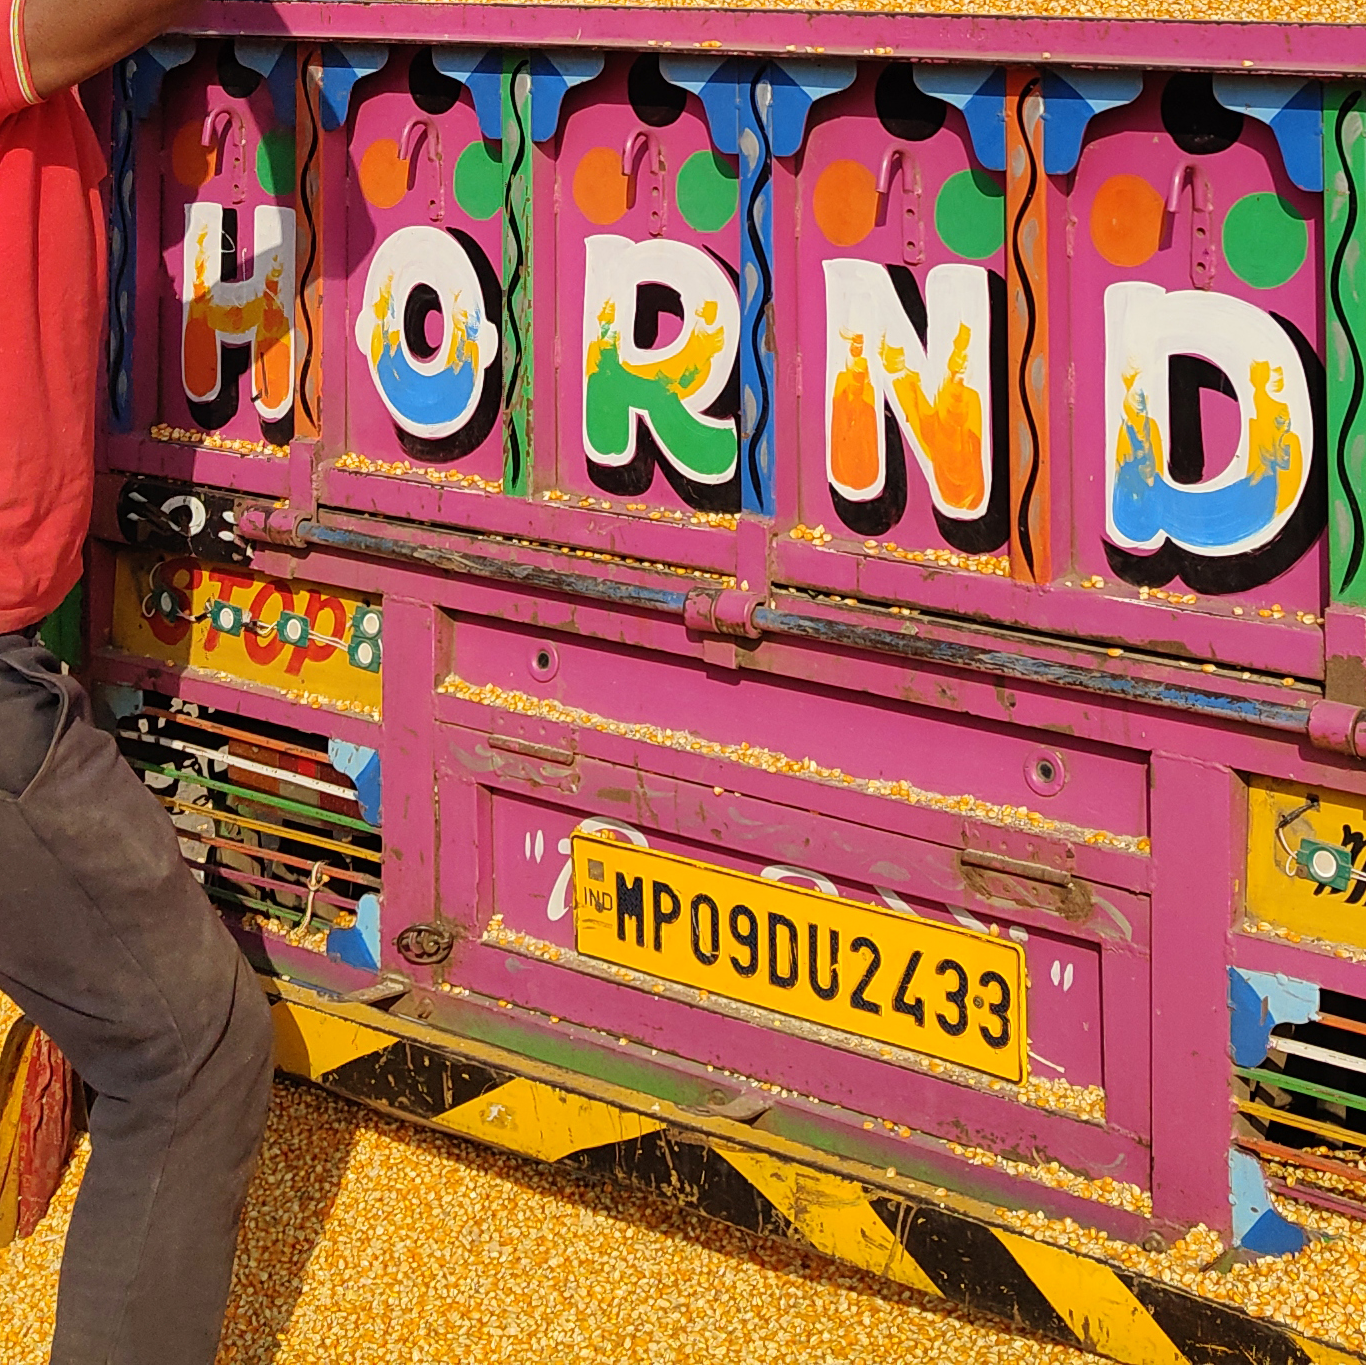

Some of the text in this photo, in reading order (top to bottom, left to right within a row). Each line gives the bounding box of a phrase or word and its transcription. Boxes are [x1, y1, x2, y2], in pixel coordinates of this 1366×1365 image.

[139, 556, 352, 678] STOP
[583, 885, 614, 912] IND
[616, 871, 1012, 1050] MP09DU2433
